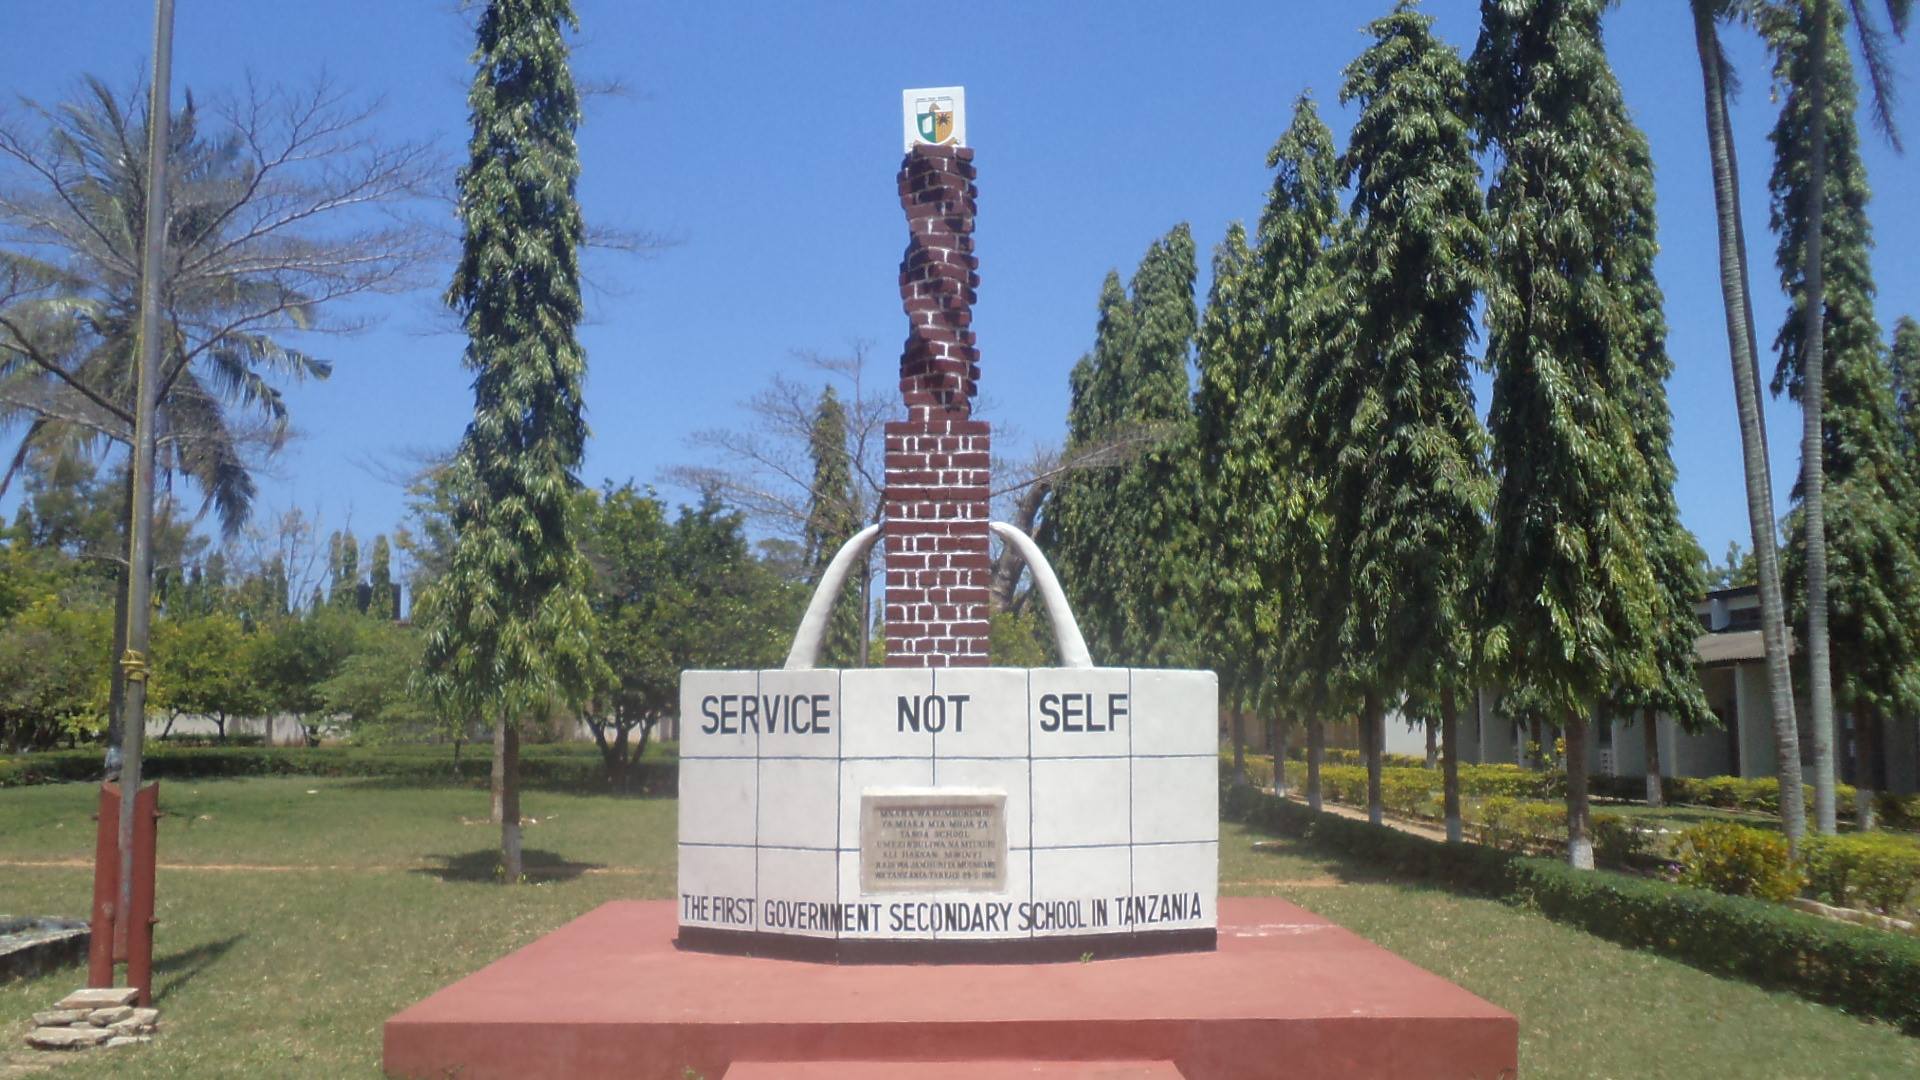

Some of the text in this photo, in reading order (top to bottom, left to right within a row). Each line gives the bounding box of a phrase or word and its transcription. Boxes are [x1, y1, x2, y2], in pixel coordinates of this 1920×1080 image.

[701, 693, 1128, 735] SERVICE NOT SELF
[935, 830, 970, 838] SCHOOL
[682, 892, 1202, 932] THE FIRST GOVERNMENT SECONDARY SCHOOL IN TANZANIA
